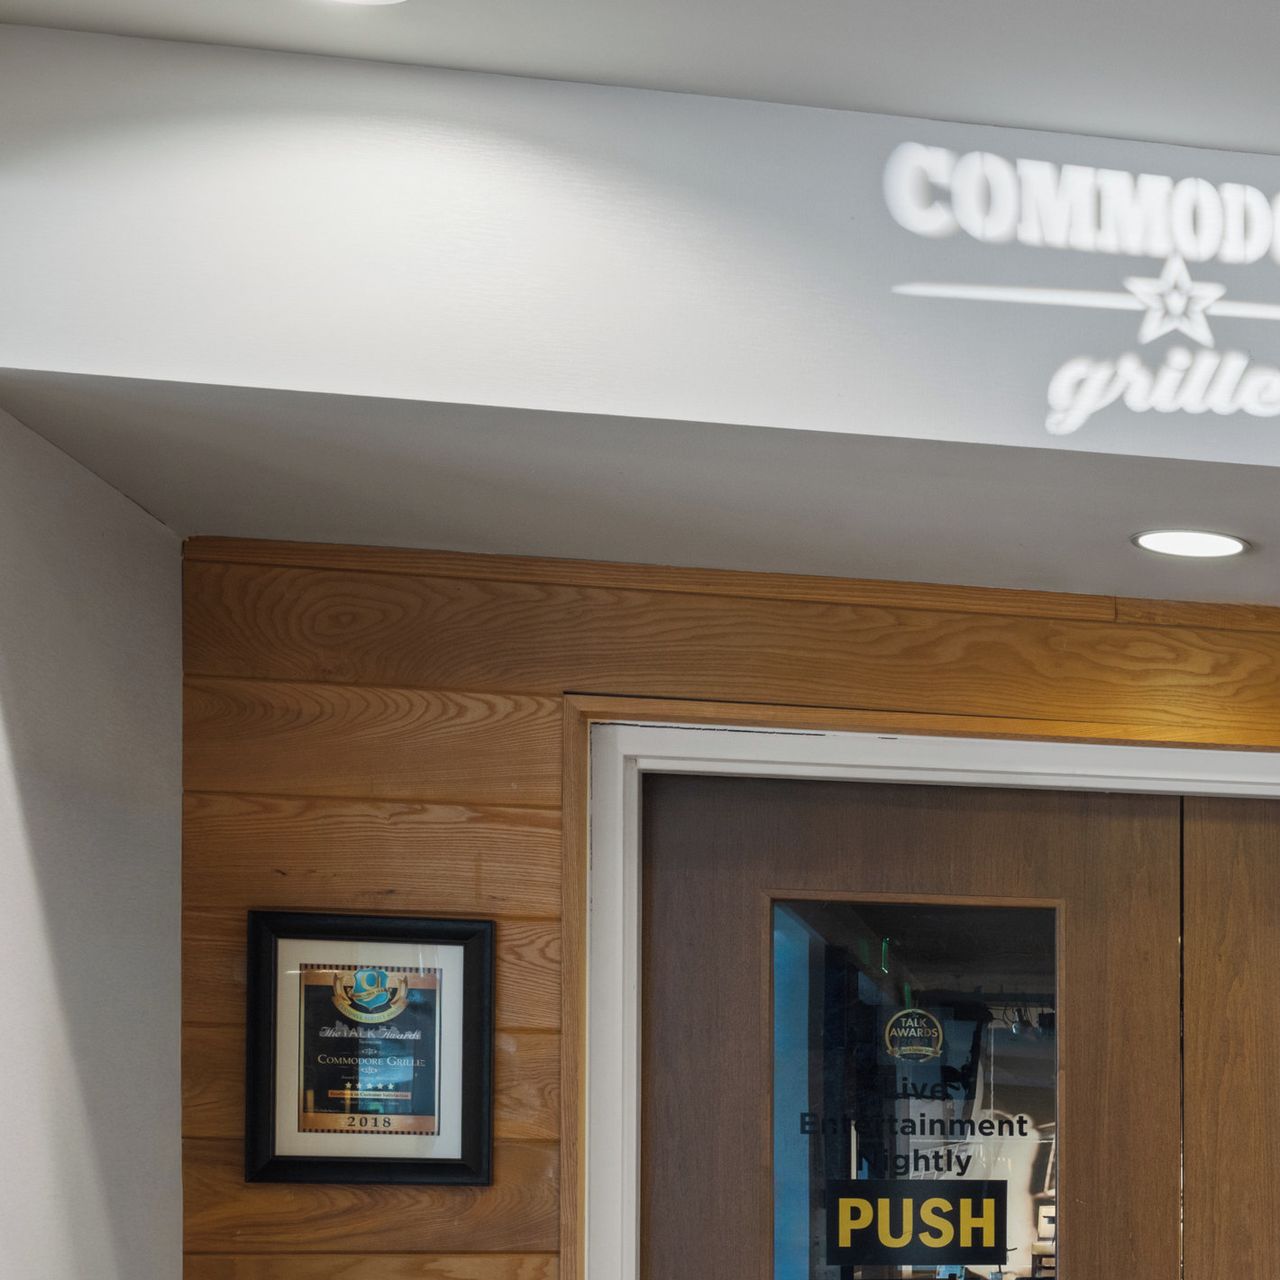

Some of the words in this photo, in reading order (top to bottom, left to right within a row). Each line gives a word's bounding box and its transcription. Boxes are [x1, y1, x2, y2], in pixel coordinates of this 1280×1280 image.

[900, 1018, 928, 1027] TALK
[889, 1028, 938, 1037] AWARDS
[347, 1116, 391, 1127] 2018
[800, 1112, 1028, 1136] Entertainment
[857, 1149, 972, 1177] Nightly
[837, 1197, 996, 1248] PUSH
